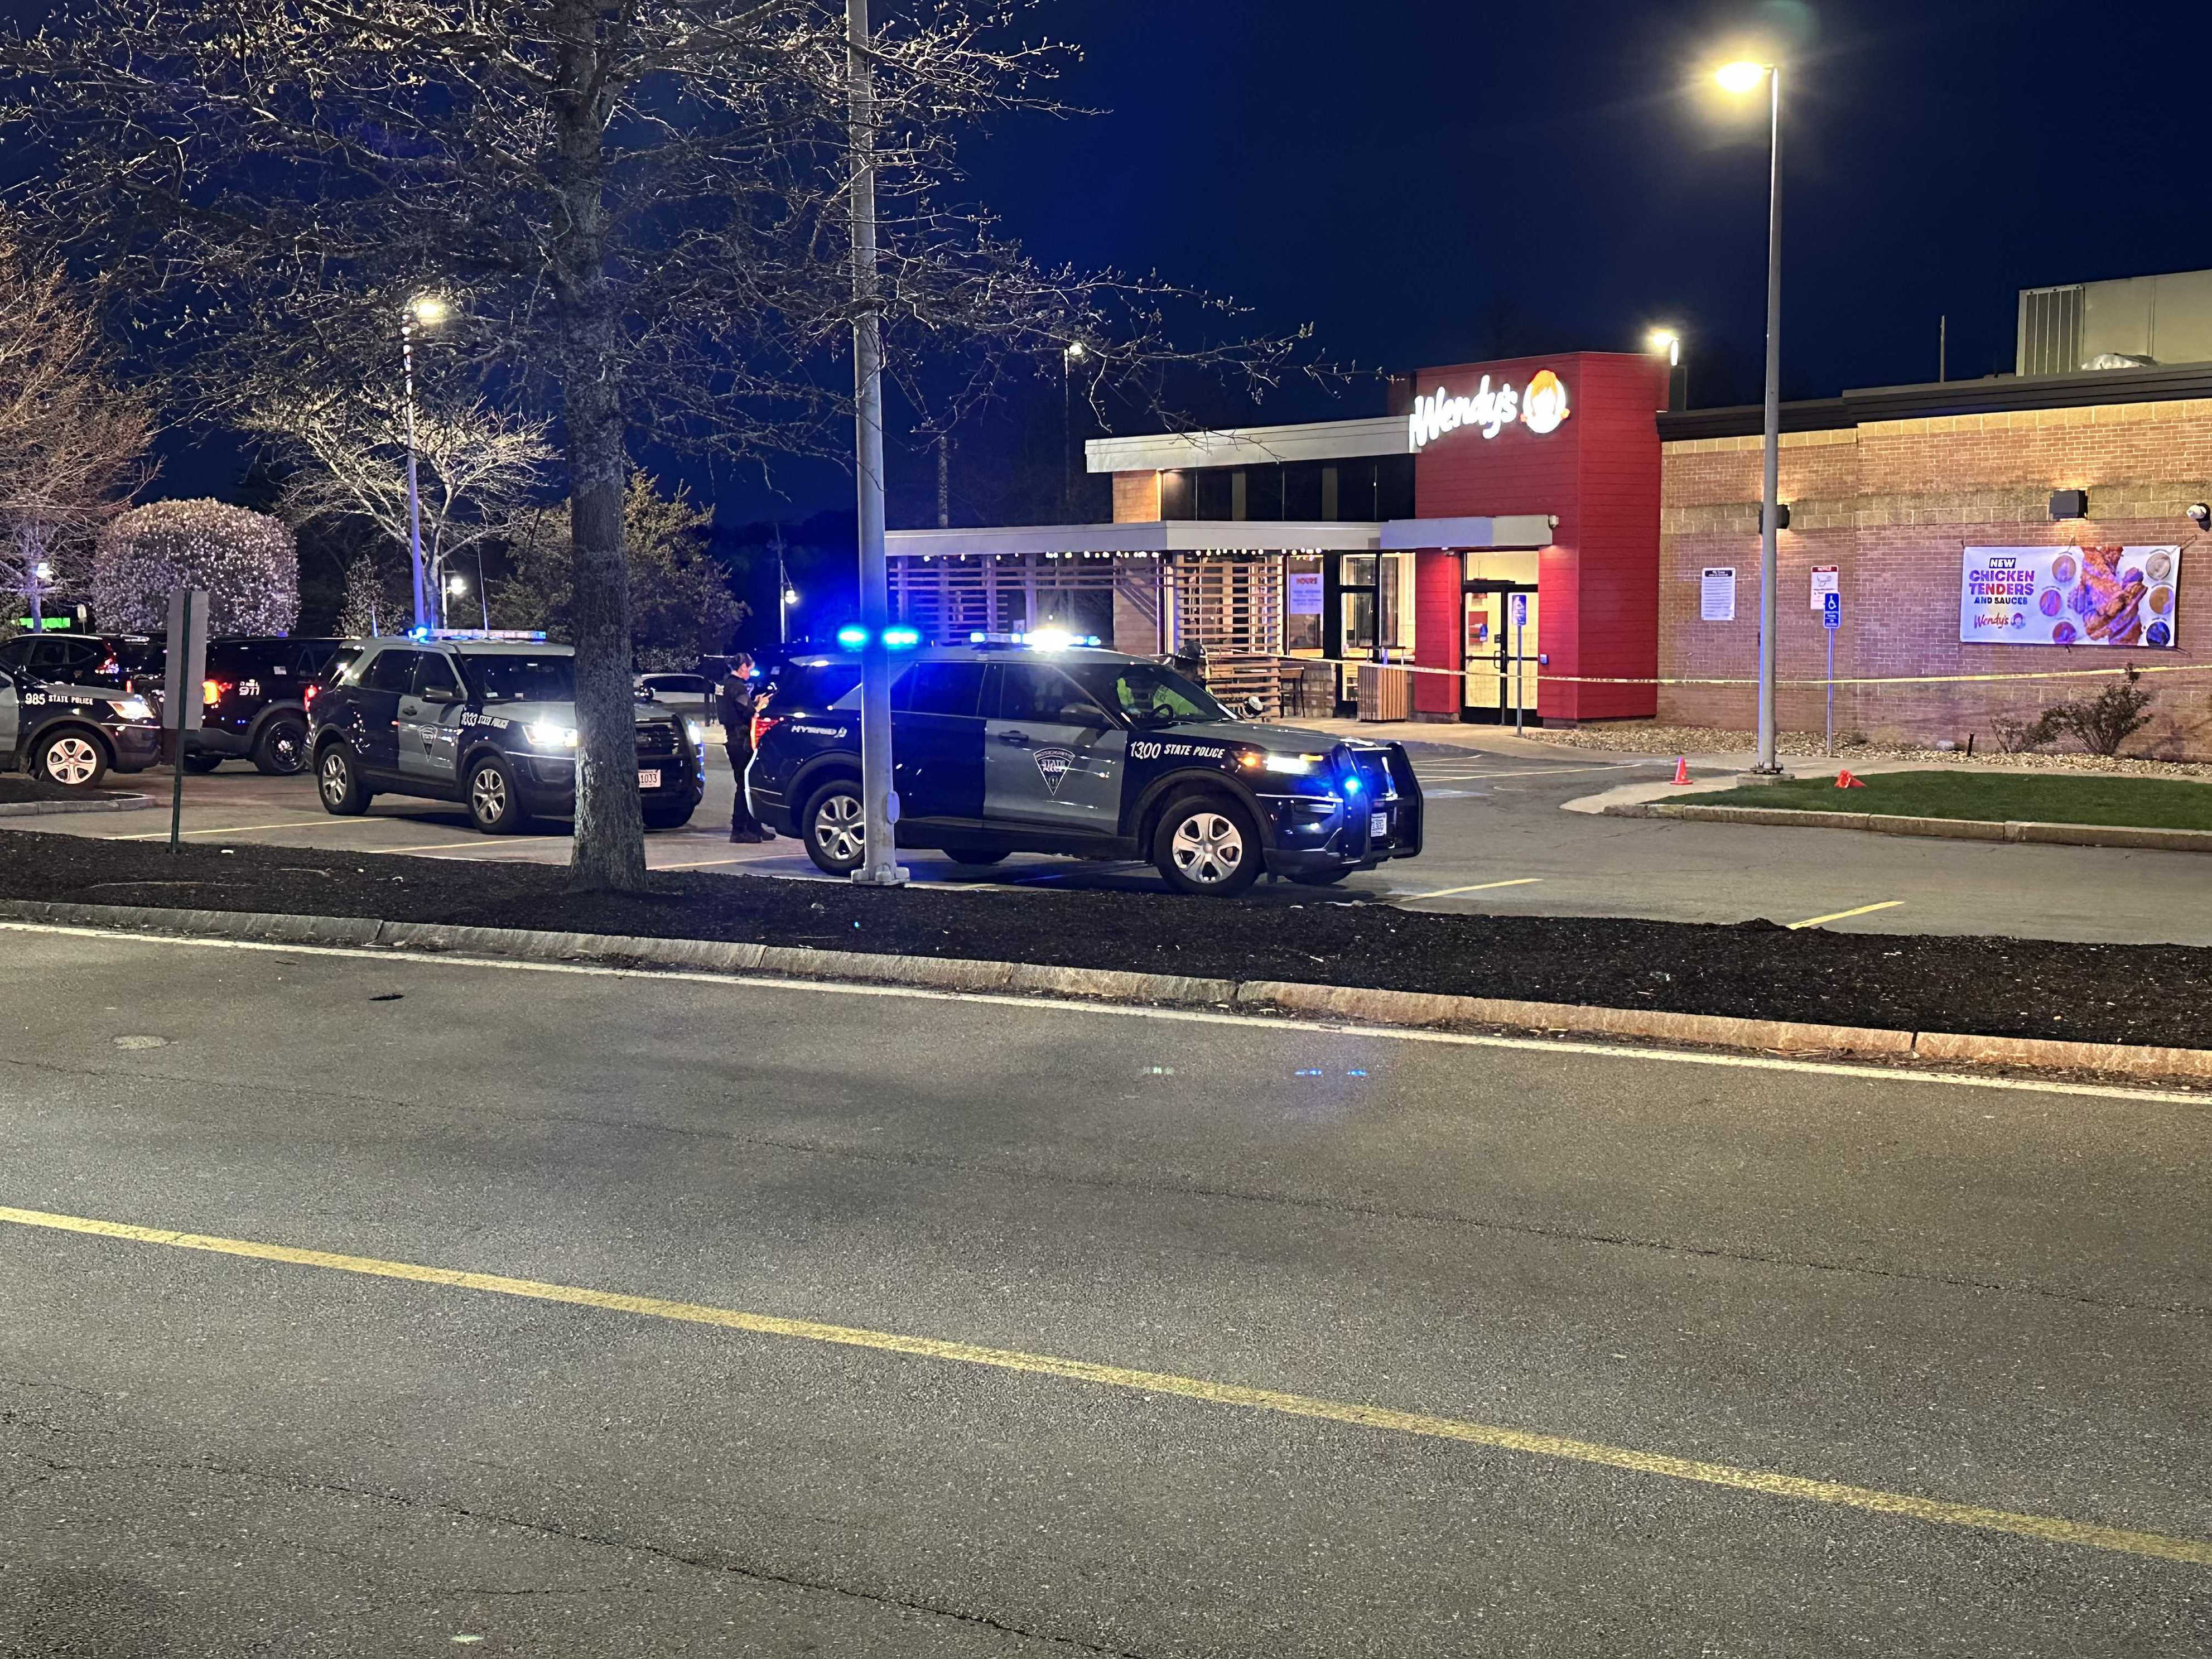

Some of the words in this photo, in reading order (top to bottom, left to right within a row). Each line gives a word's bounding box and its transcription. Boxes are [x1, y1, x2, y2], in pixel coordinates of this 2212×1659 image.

[1409, 375, 1517, 447] Wendy's
[1990, 558, 2015, 568] NEW
[1969, 570, 2035, 582] CHICKEN
[1969, 583, 2034, 595] TENDERS
[1974, 613, 2009, 629] Wendy's
[25, 693, 46, 705] 985
[49, 695, 68, 703] STATE
[71, 697, 93, 705] POLICE
[1130, 741, 1162, 759] 1300
[1164, 744, 1192, 755] STATE
[1193, 746, 1225, 759] POLICE
[641, 774, 657, 783] 1033
